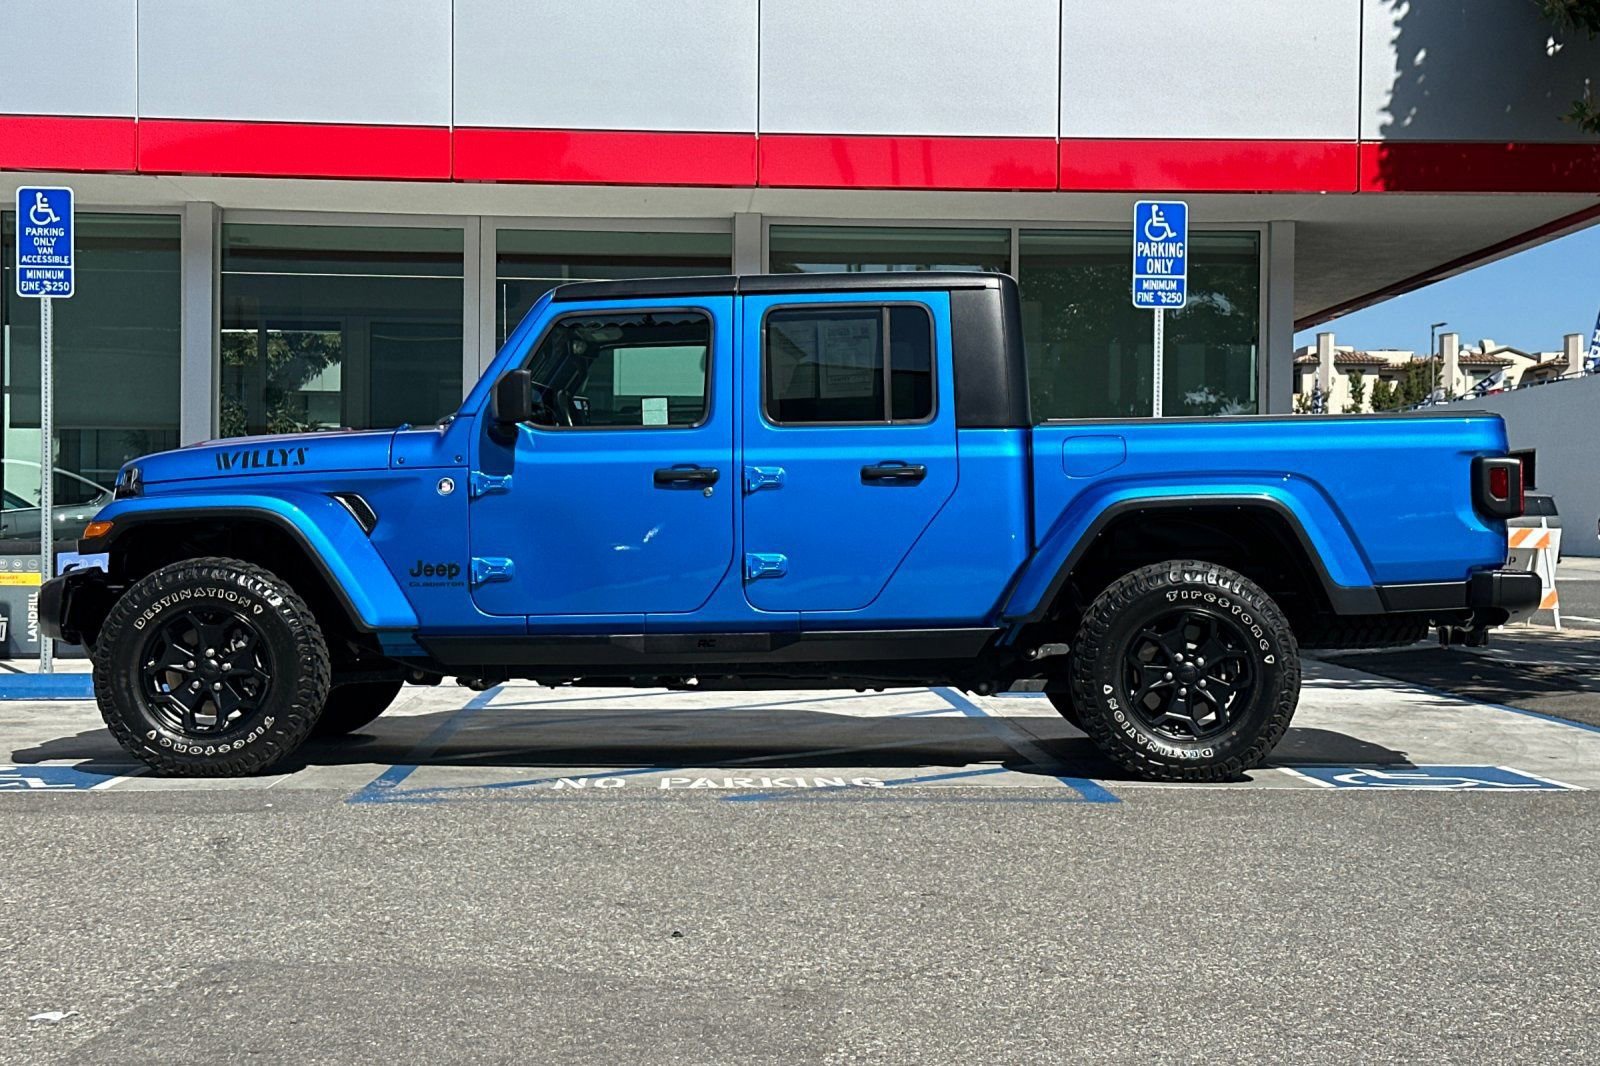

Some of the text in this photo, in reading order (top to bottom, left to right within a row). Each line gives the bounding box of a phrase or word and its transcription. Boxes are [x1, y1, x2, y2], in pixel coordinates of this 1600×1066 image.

[25, 227, 64, 236] PARKING
[33, 237, 57, 246] ONLY
[37, 247, 53, 255] VAN
[1137, 242, 1183, 258] PARKING
[21, 255, 69, 264] ACCESSIBLE
[1146, 258, 1174, 274] ONLY
[26, 270, 64, 280] MINIMUM
[1142, 280, 1177, 291] MINIMUM
[1137, 292, 1182, 303] FINE $250
[215, 447, 309, 471] WILLYS
[409, 559, 461, 580] Jeep
[133, 587, 251, 630] DESTINATION
[27, 591, 39, 642] LANDFILL
[697, 639, 716, 648] RC
[1107, 698, 1214, 759] DESTINATION
[551, 776, 885, 790] NO PARKING
